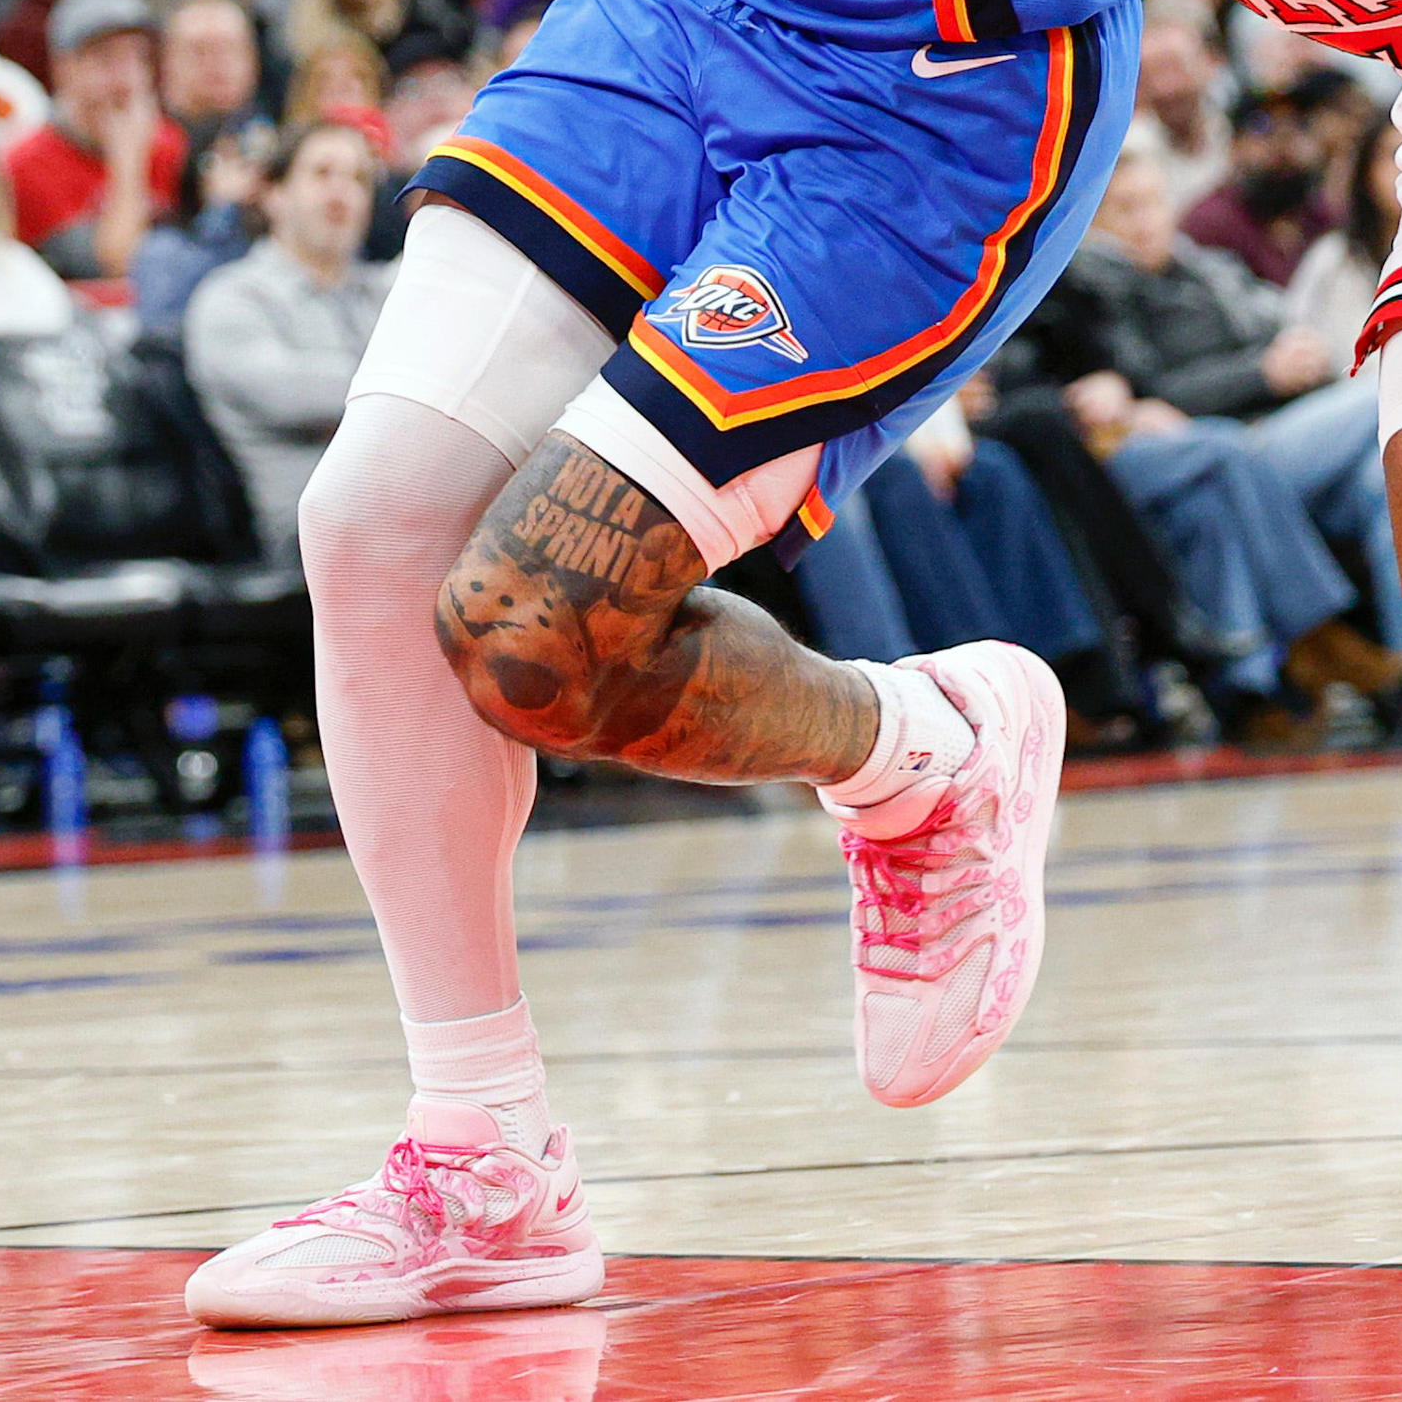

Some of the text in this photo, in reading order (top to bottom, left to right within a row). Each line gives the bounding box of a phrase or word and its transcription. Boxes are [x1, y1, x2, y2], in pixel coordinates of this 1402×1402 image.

[674, 283, 766, 321] OKC
[547, 453, 645, 530] NOT A
[513, 494, 640, 584] SPRINT
